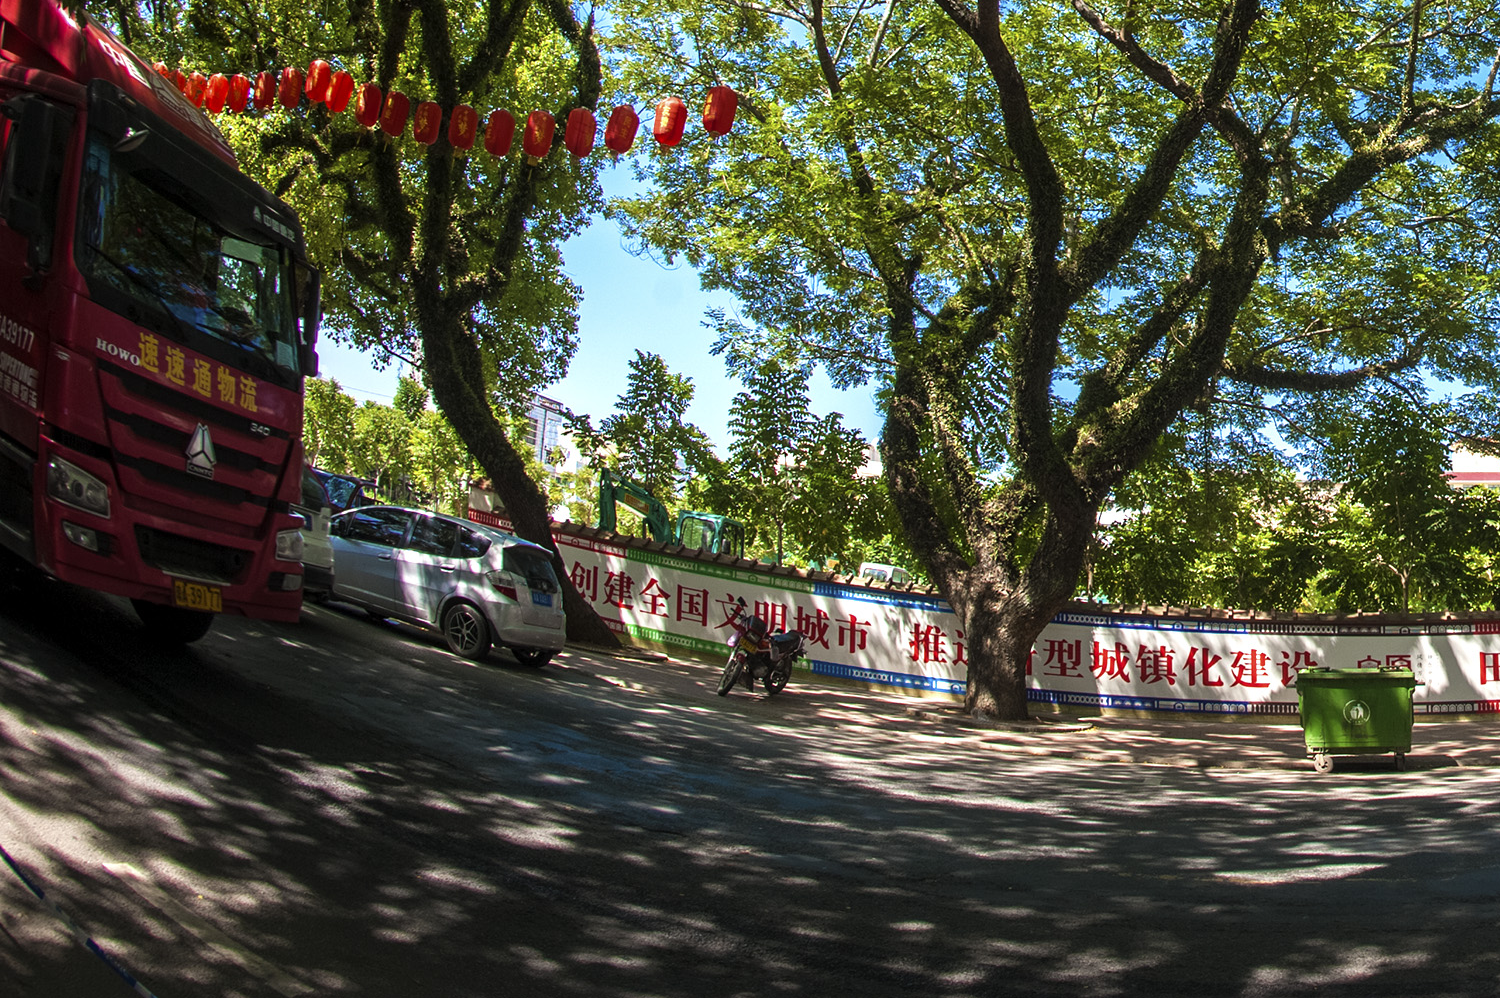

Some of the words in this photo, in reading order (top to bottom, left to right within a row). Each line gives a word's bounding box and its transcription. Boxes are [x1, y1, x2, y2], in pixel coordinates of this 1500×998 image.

[0, 314, 35, 353] A39177
[96, 337, 141, 367] HOWO
[138, 331, 258, 413] 速速通物流
[251, 422, 271, 436] 340
[569, 560, 873, 655] 创建全国文明城市
